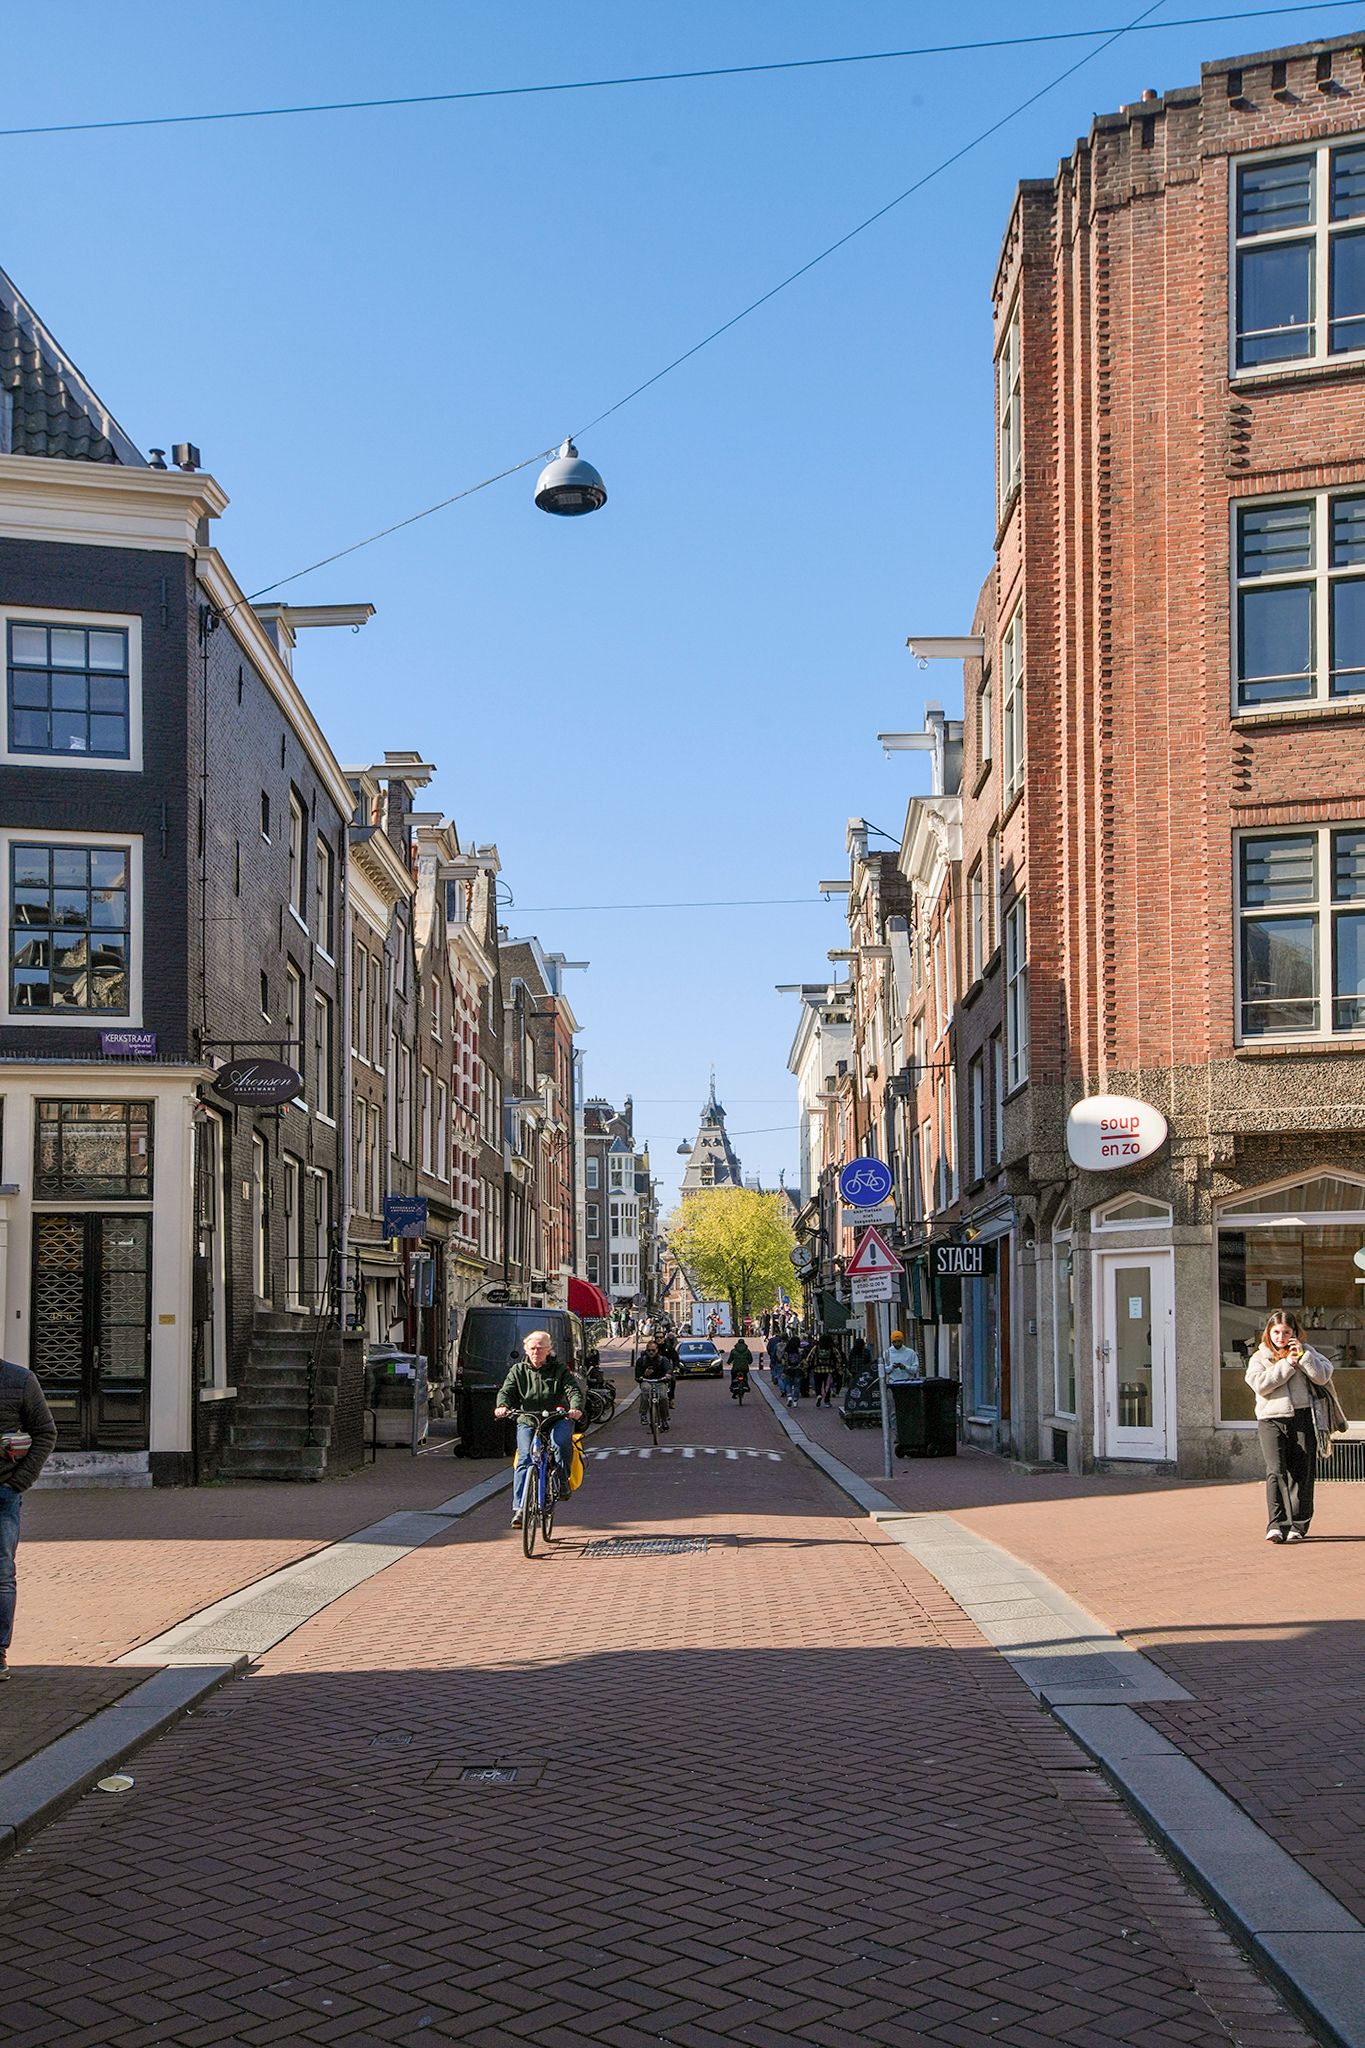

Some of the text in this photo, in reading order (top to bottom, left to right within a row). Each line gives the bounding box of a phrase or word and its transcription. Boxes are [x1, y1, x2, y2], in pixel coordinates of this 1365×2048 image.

[105, 1033, 151, 1043] KERKSTRAAT
[218, 1065, 291, 1090] Aronson
[1101, 1116, 1140, 1132] soup
[1101, 1142, 1140, 1157] en zo
[937, 1247, 982, 1271] STACH
